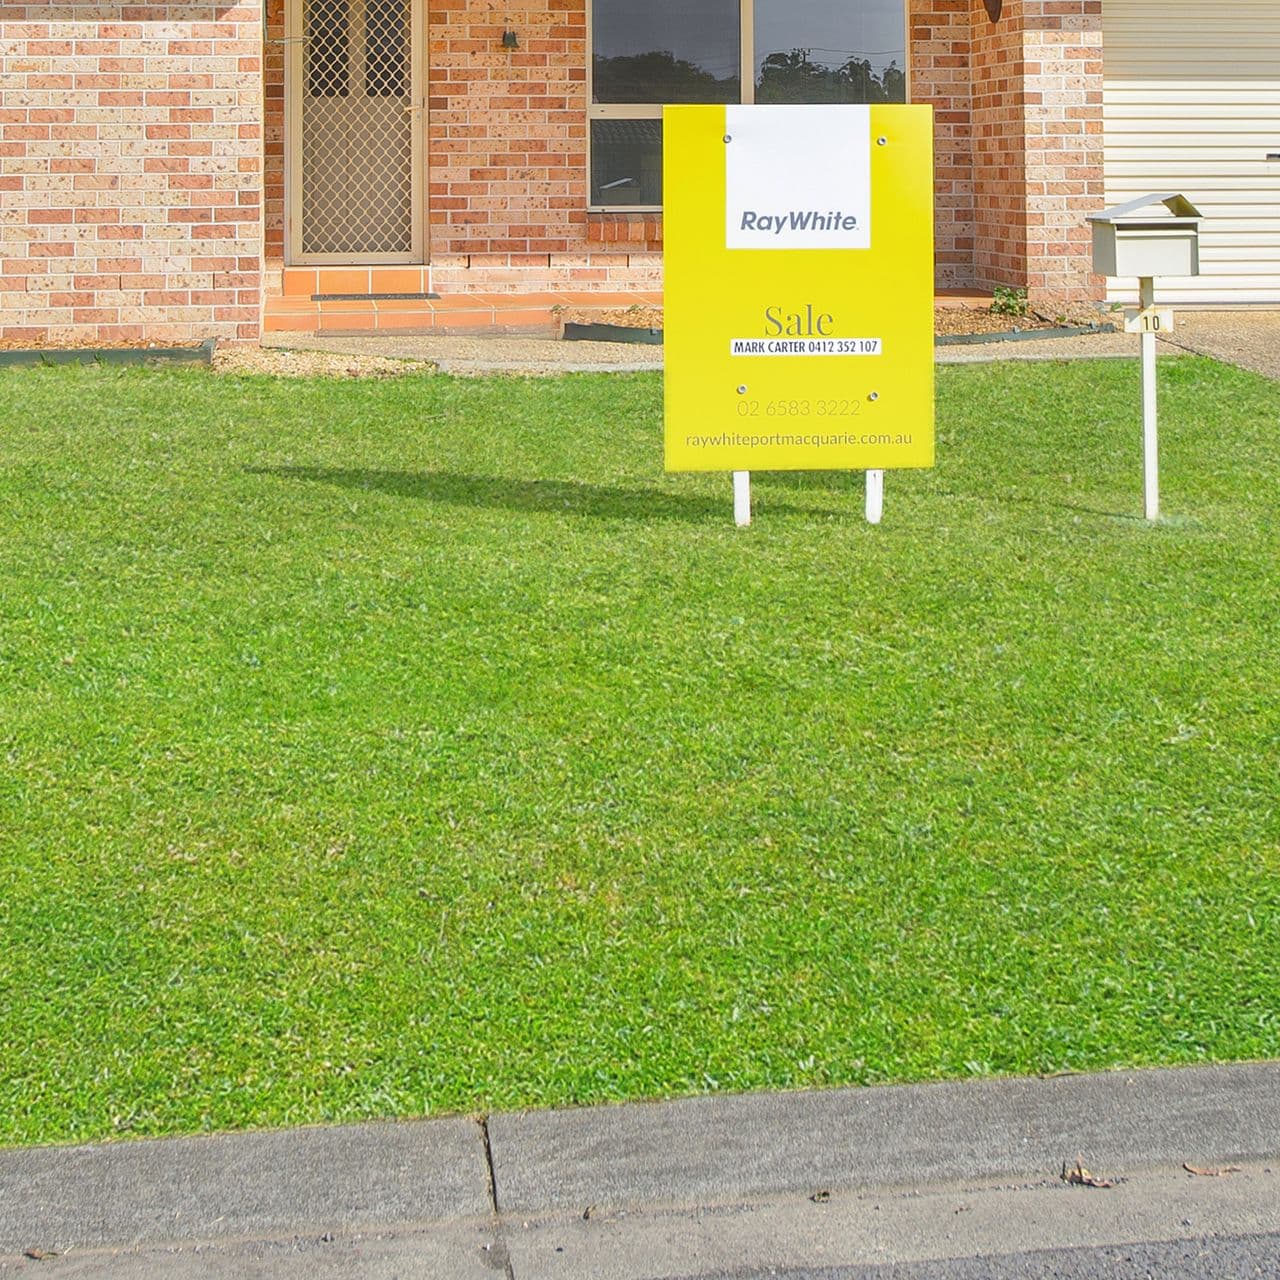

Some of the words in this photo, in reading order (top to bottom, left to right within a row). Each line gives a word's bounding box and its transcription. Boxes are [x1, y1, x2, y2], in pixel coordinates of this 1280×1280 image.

[740, 211, 857, 234] RayWhite
[765, 304, 834, 336] Sale
[1143, 316, 1160, 331] 10
[734, 341, 765, 353] MARK
[768, 341, 805, 353] CARTER
[808, 341, 834, 353] 0412
[837, 341, 856, 353] 352
[859, 340, 878, 353] 107
[737, 400, 759, 416] 02
[766, 400, 811, 416] 6583
[816, 399, 861, 416] 3222
[686, 431, 912, 448] raywhiteportmacquarie.com.au
